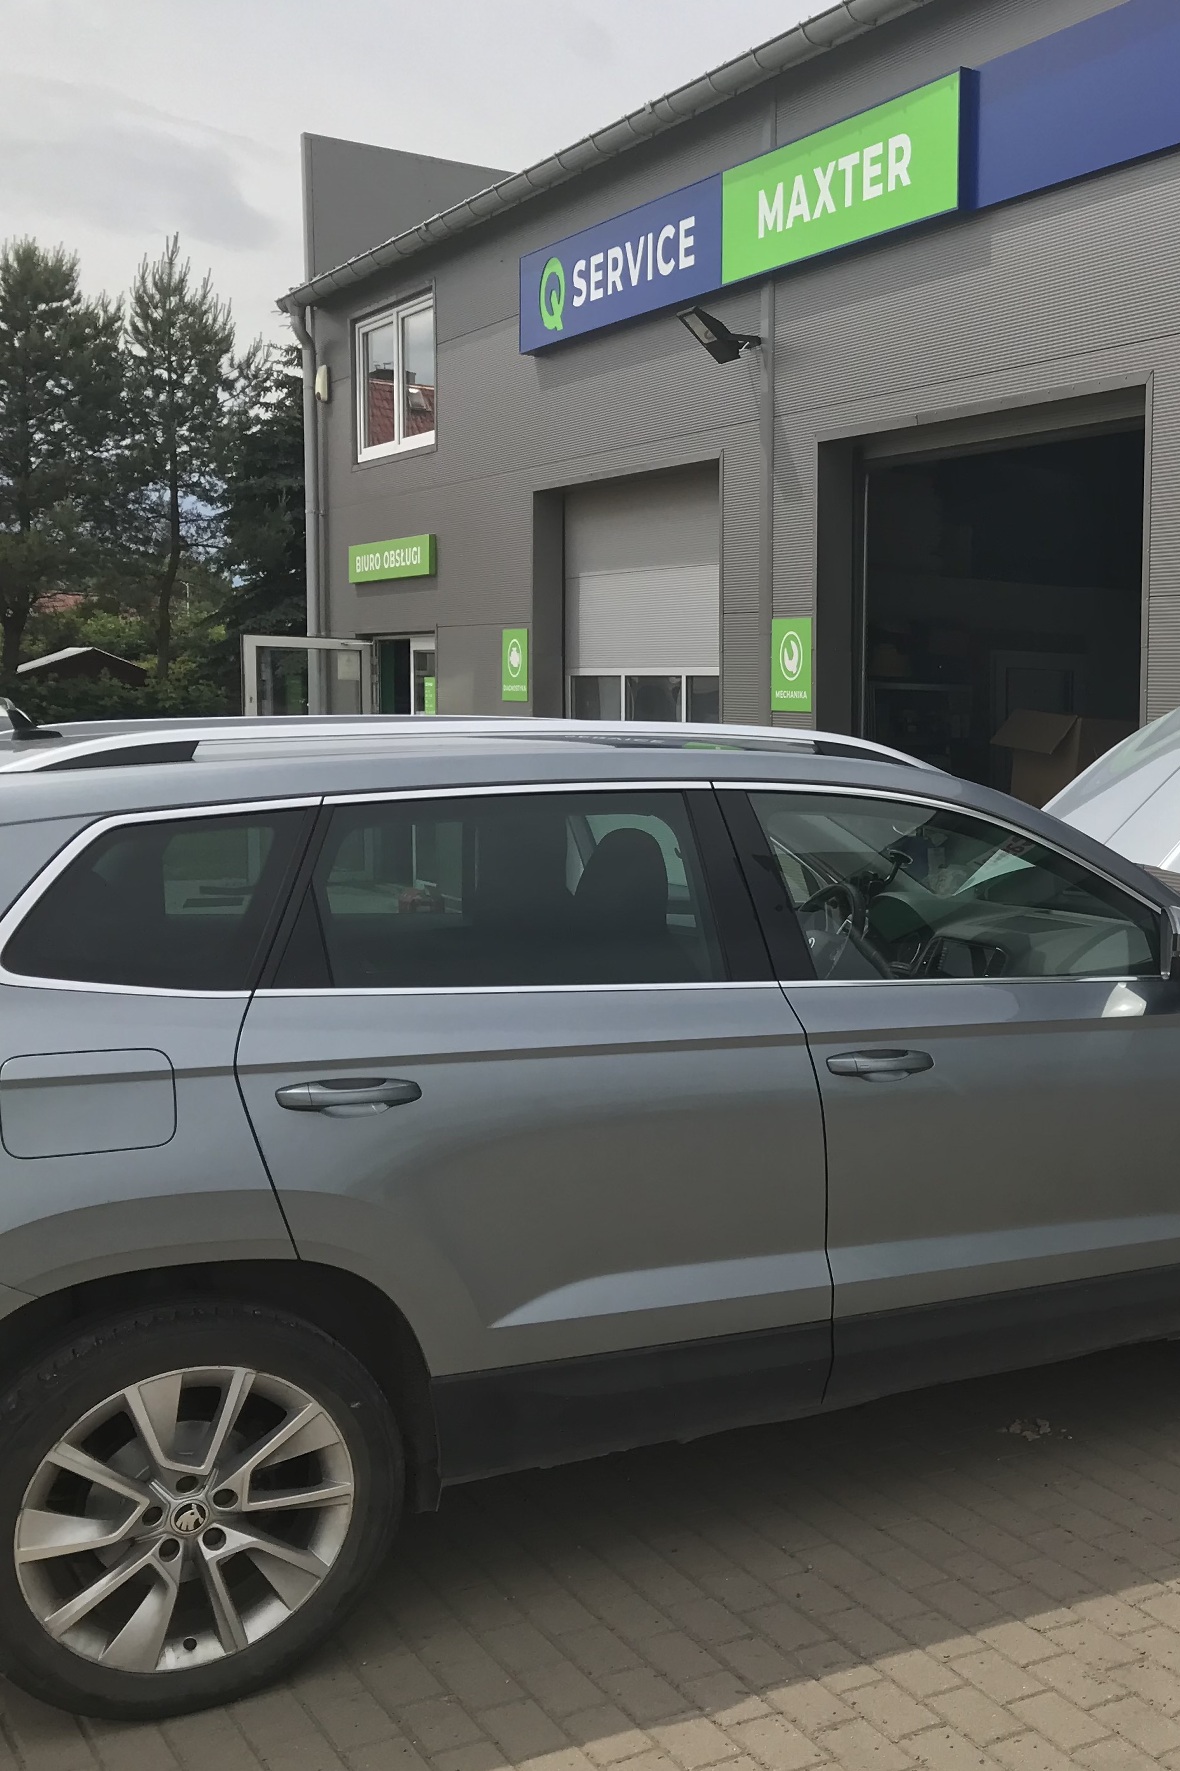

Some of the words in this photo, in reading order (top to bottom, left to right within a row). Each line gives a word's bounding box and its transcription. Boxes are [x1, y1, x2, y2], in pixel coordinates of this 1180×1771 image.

[757, 132, 912, 239] MAXTER
[572, 215, 696, 308] SERVICE
[355, 552, 381, 573] BIURO
[383, 546, 421, 569] OBSŁUGI
[775, 690, 808, 699] MECHANIKA
